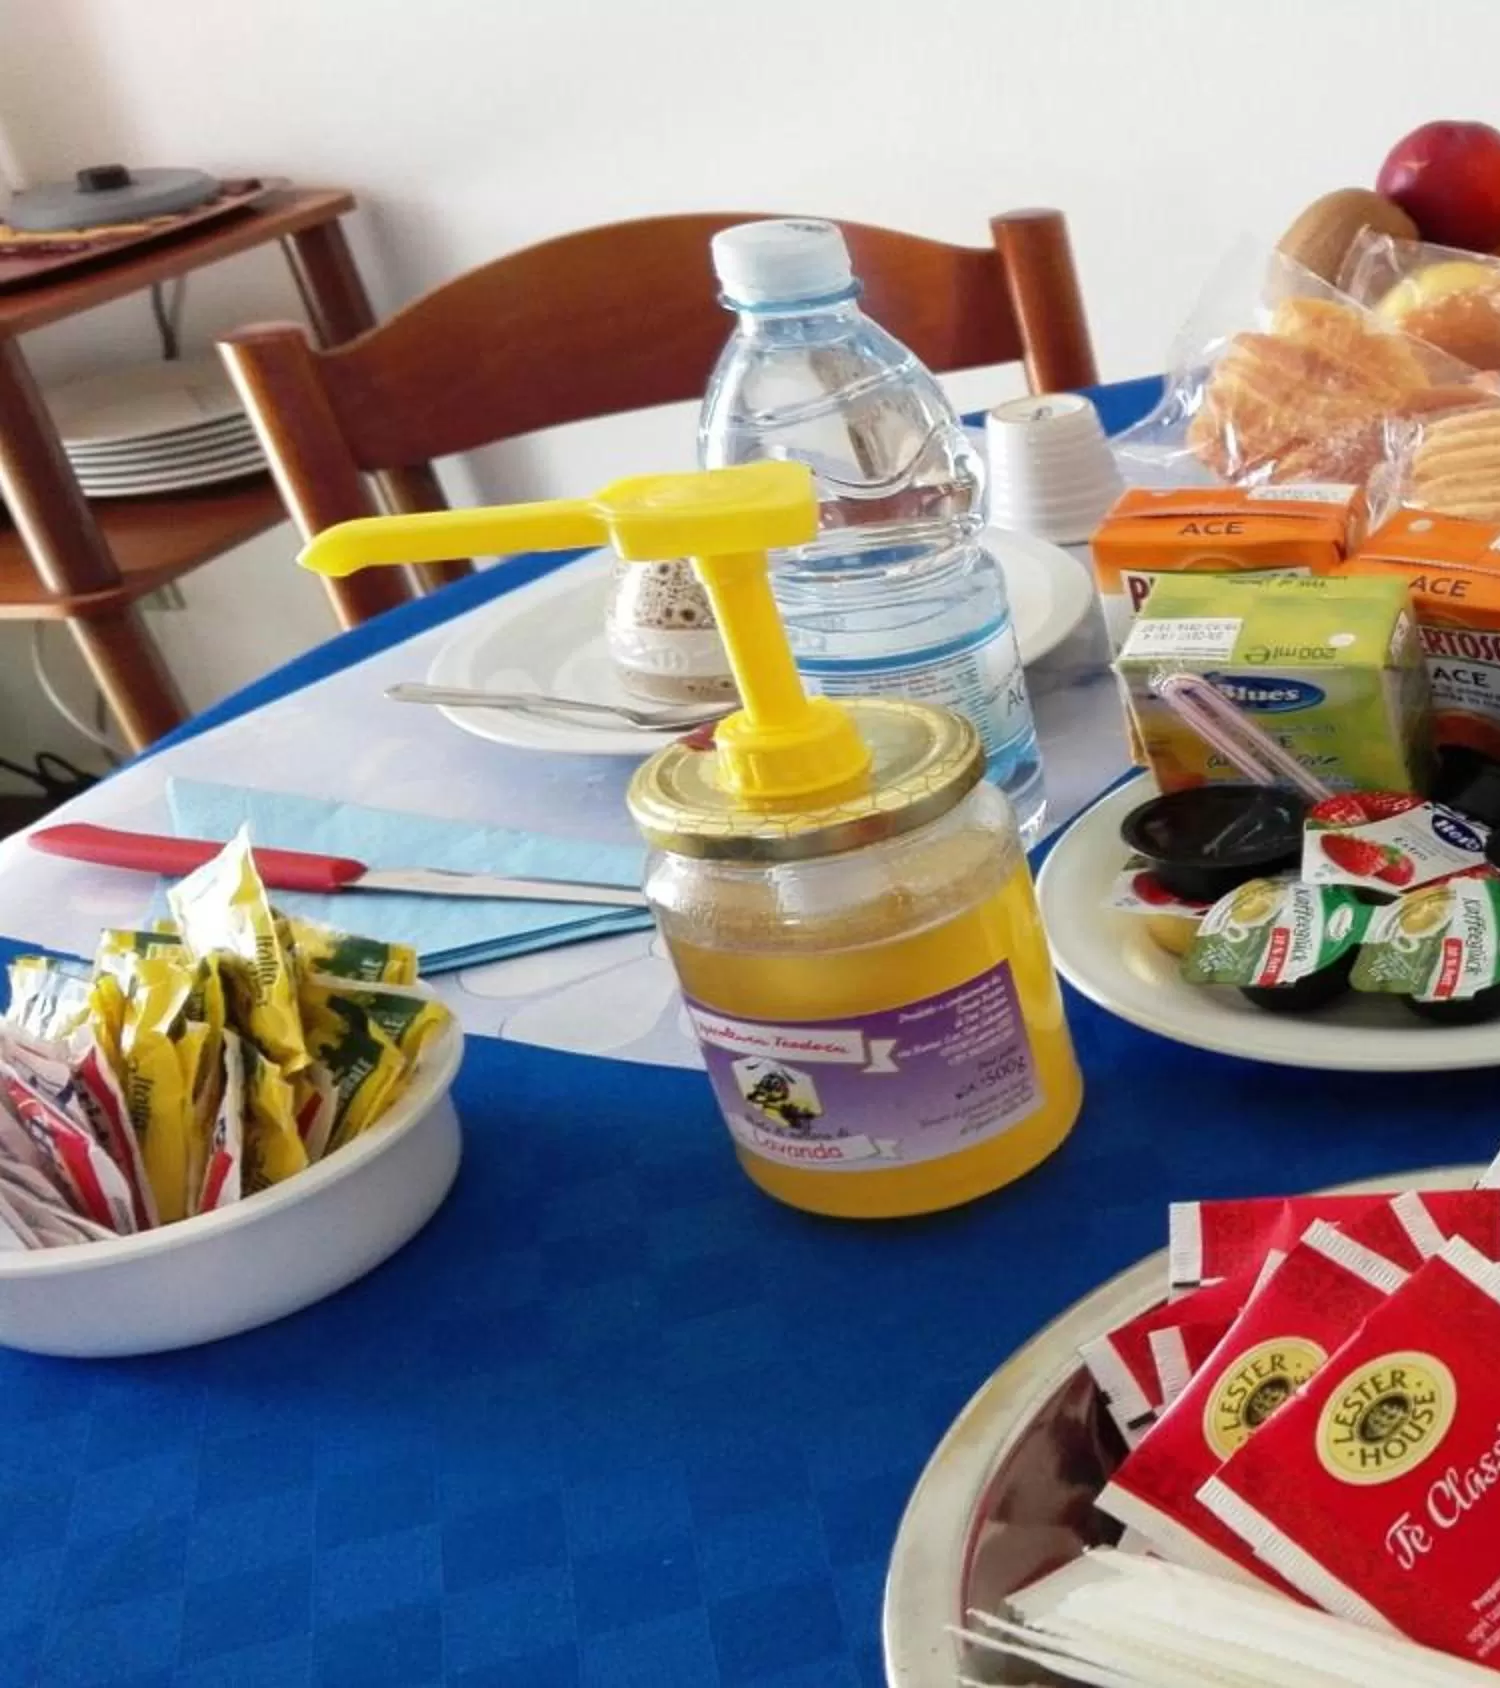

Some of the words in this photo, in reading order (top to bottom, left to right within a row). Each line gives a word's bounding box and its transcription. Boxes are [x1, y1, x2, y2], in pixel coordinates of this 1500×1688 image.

[1178, 521, 1245, 535] ACE
[1409, 575, 1471, 597] ACE
[1433, 666, 1490, 688] ACE
[1221, 1352, 1289, 1431] LESTER
[1334, 1369, 1410, 1443] LESTER
[1360, 1390, 1437, 1467] HOUSE
